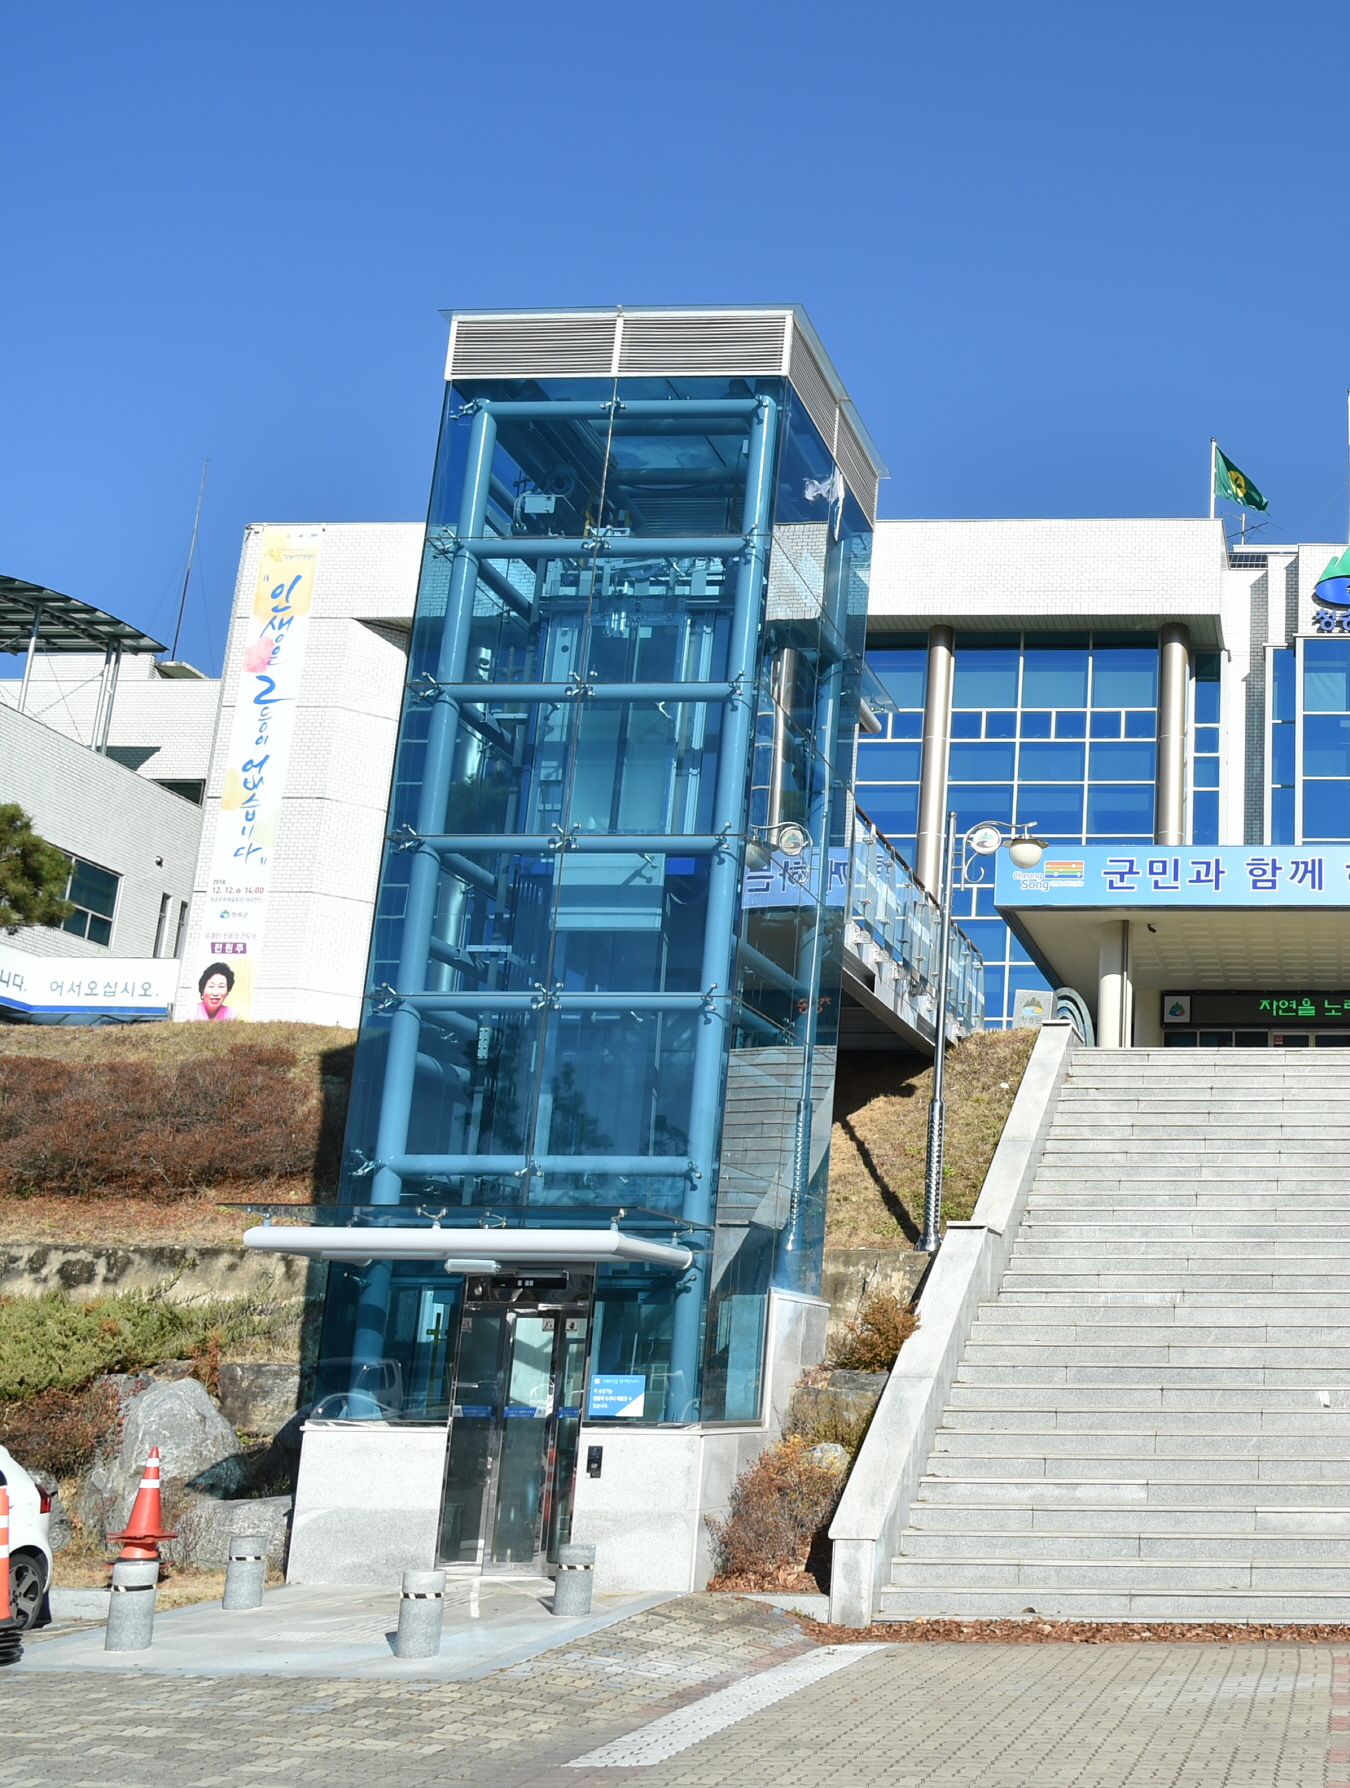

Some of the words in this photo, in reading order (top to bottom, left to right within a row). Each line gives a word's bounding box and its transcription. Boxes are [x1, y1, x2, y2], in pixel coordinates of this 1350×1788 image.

[1102, 857, 1227, 892] 군민과
[1245, 857, 1324, 892] 함께
[1021, 879, 1049, 892] Song
[214, 942, 244, 954] 전원주
[50, 980, 159, 997] 어서오십시오.
[1259, 997, 1316, 1016] 자연을
